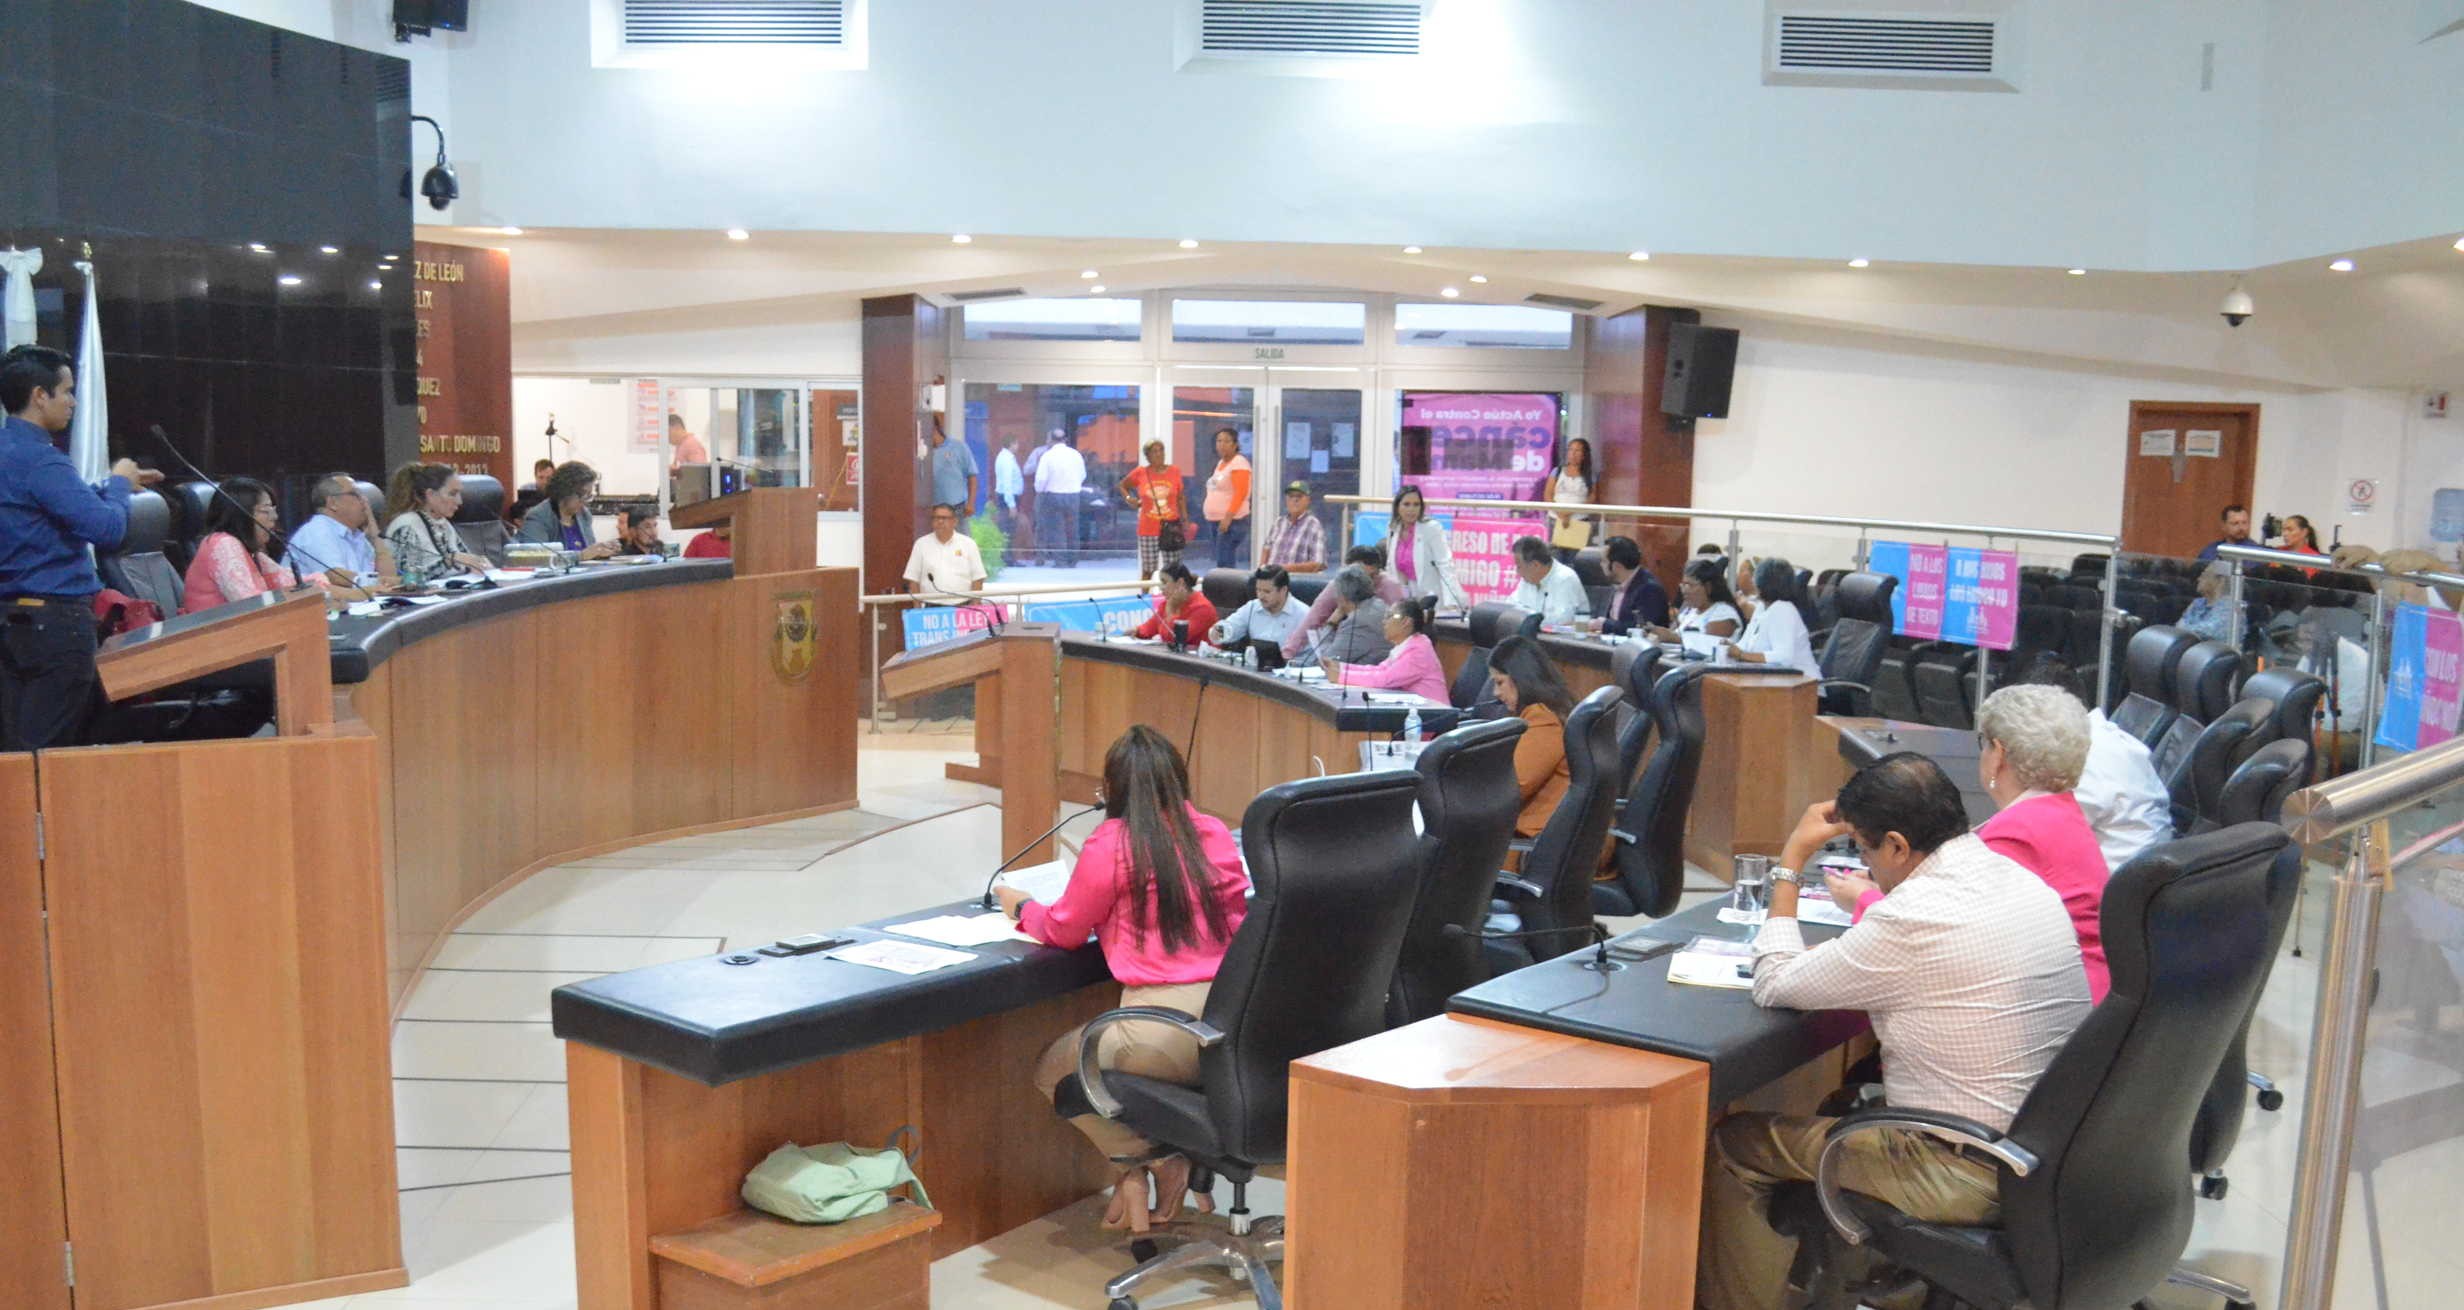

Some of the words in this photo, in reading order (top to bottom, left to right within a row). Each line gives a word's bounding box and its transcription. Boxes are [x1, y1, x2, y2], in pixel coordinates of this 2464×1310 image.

[414, 261, 422, 279] Z
[423, 262, 436, 280] DE
[438, 260, 464, 282] LEÓN
[1255, 347, 1284, 359] SALIDA
[453, 434, 501, 453] DOMINGO
[1447, 530, 1488, 554] RESO
[1490, 532, 1509, 555] DE
[923, 615, 939, 630] NO
[942, 614, 950, 629] A
[953, 613, 968, 628] LA
